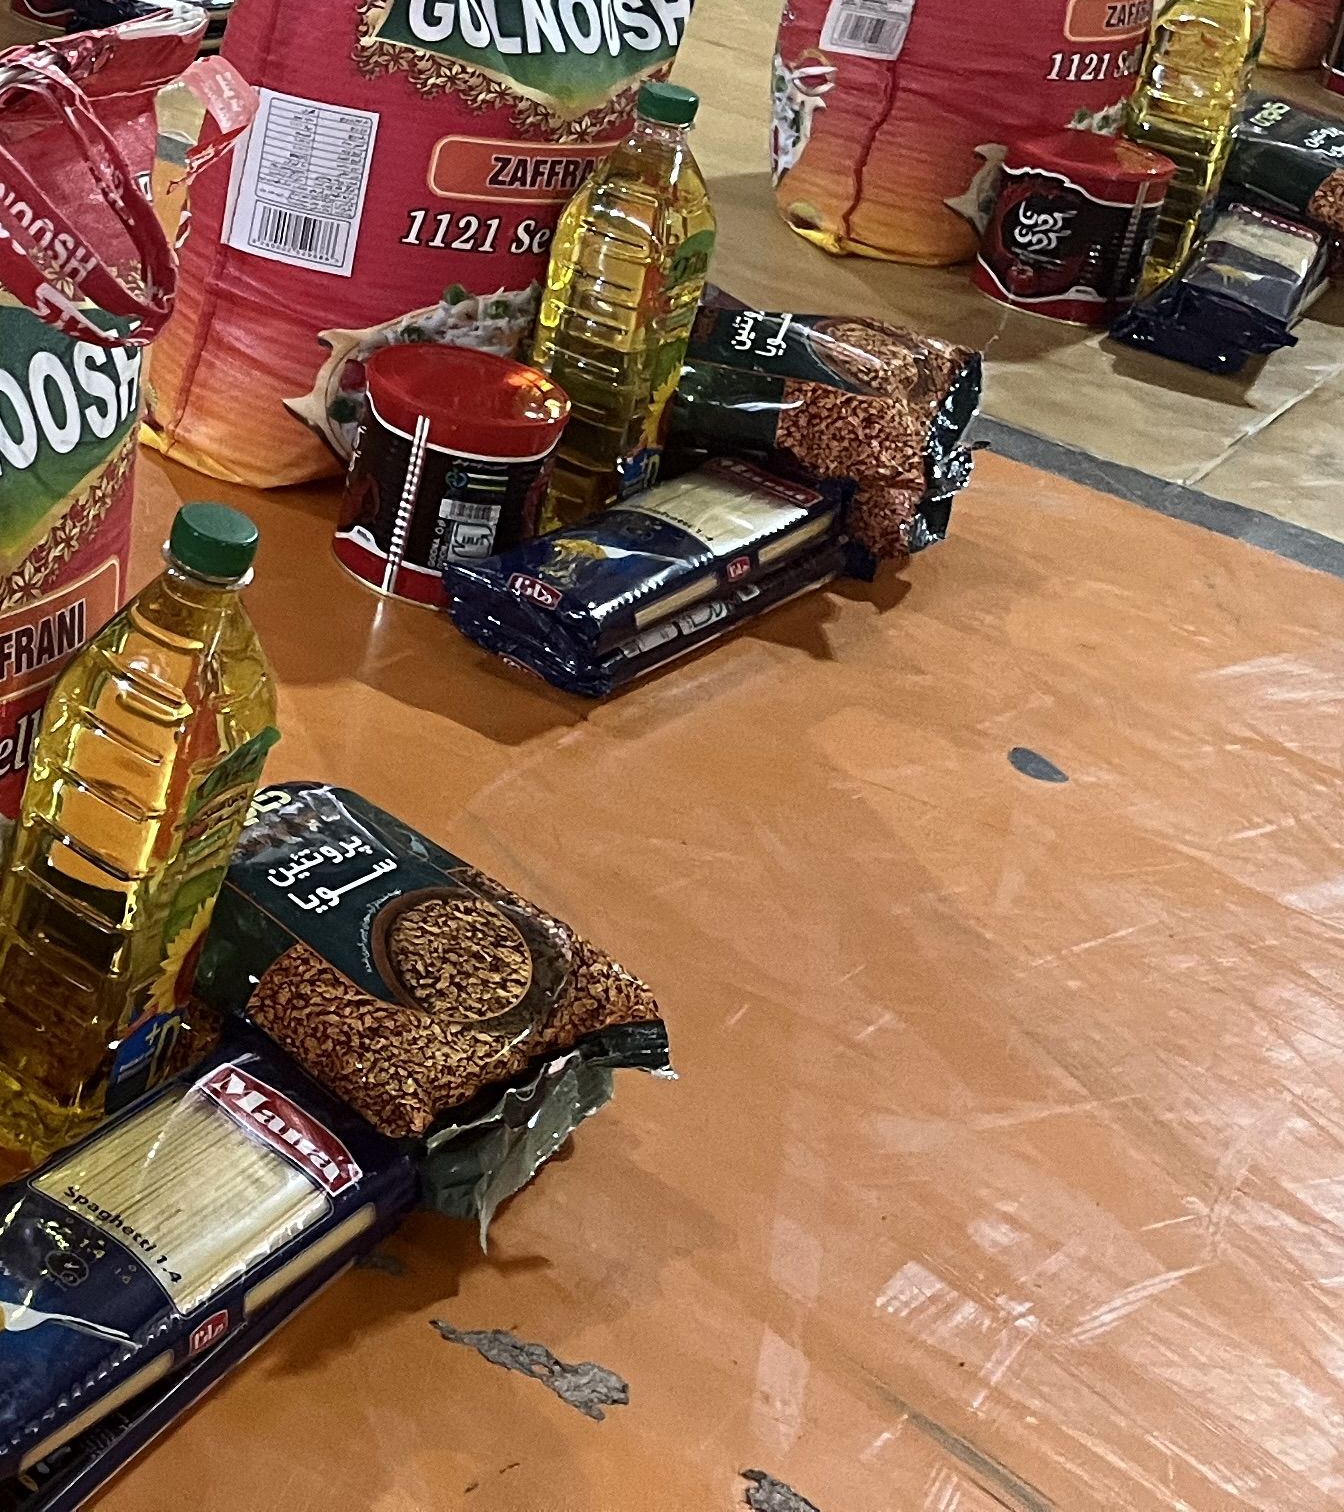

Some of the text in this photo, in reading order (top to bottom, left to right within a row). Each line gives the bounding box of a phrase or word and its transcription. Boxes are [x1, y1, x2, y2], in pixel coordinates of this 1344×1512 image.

[1047, 52, 1108, 81] 1121
[401, 210, 498, 252] 1121
[268, 833, 373, 887] پروتئین
[288, 855, 397, 914] سویا
[213, 1071, 346, 1192] Mana
[63, 1186, 158, 1254] Spaghetti
